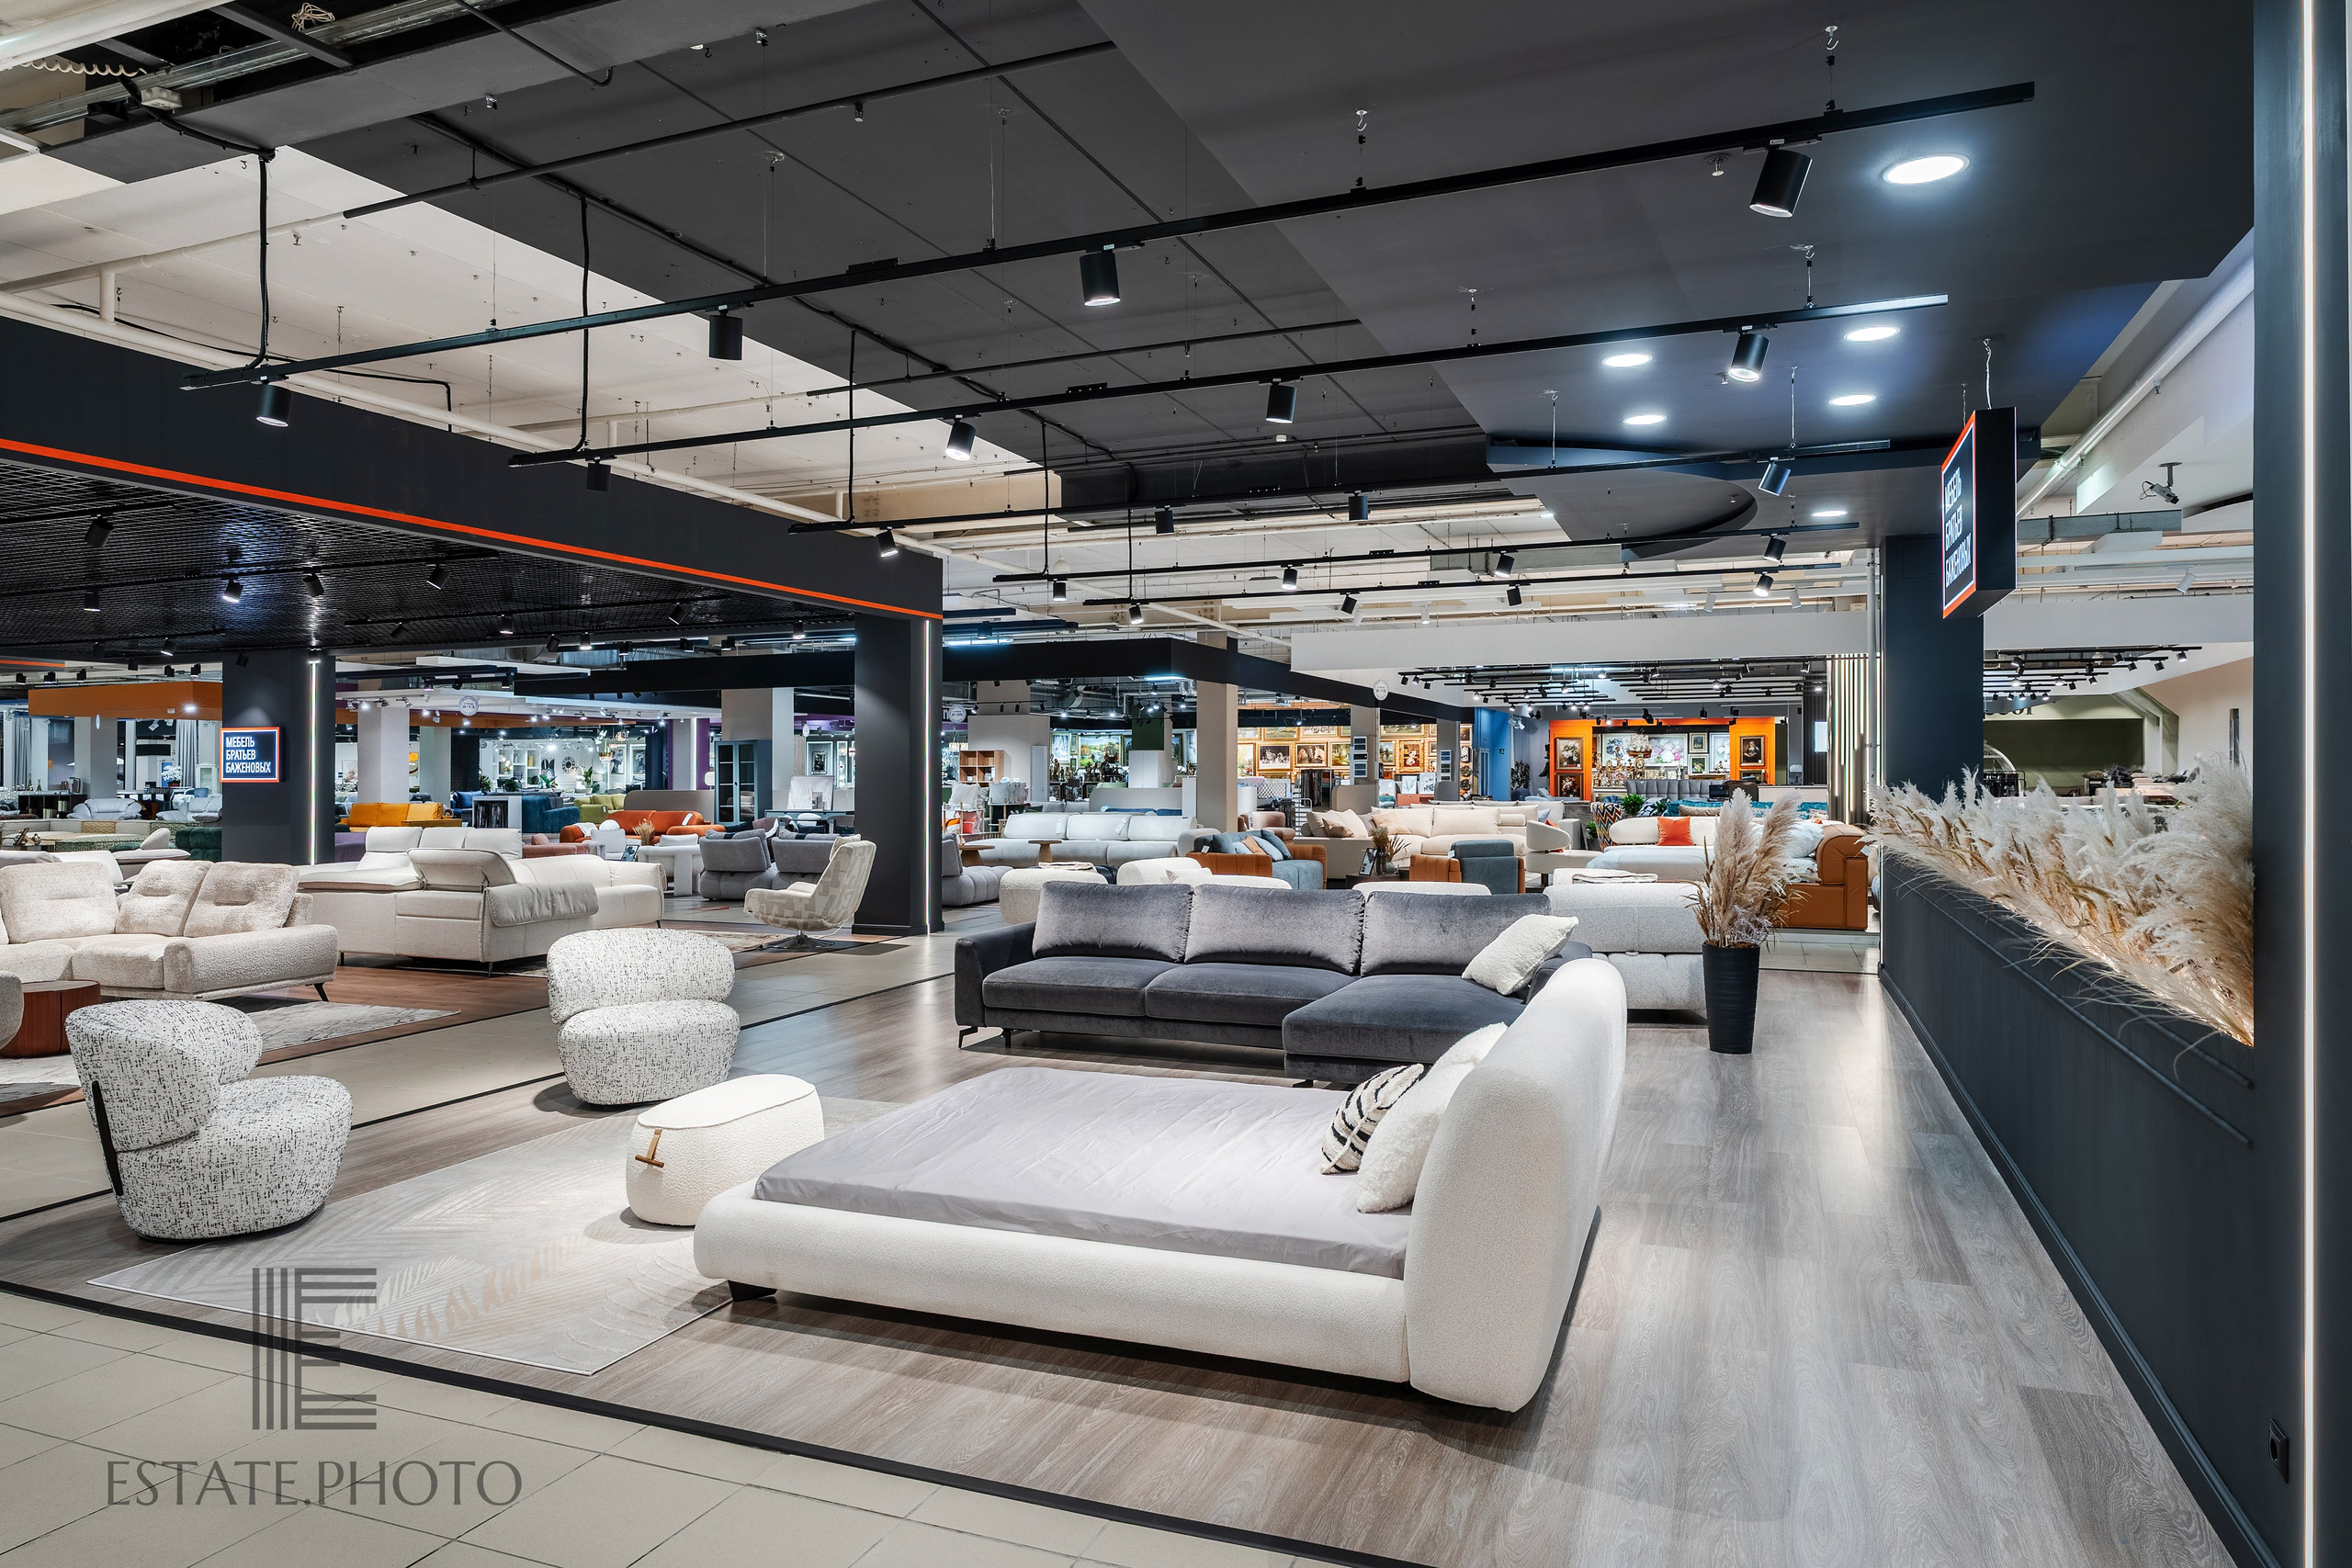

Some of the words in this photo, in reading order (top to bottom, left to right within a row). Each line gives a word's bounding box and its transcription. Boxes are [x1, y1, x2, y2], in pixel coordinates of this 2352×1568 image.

[1945, 467, 1962, 514] МЕБЕЛЬ
[1945, 504, 1963, 552] БРАТЬЕВ
[1945, 532, 1972, 588] БАЖЕНОВЫХ
[225, 736, 255, 748] МЕБЕЛЬ
[225, 749, 256, 761] БРАТЬЕВ
[225, 761, 272, 773] БАЖЕНОВЫХ
